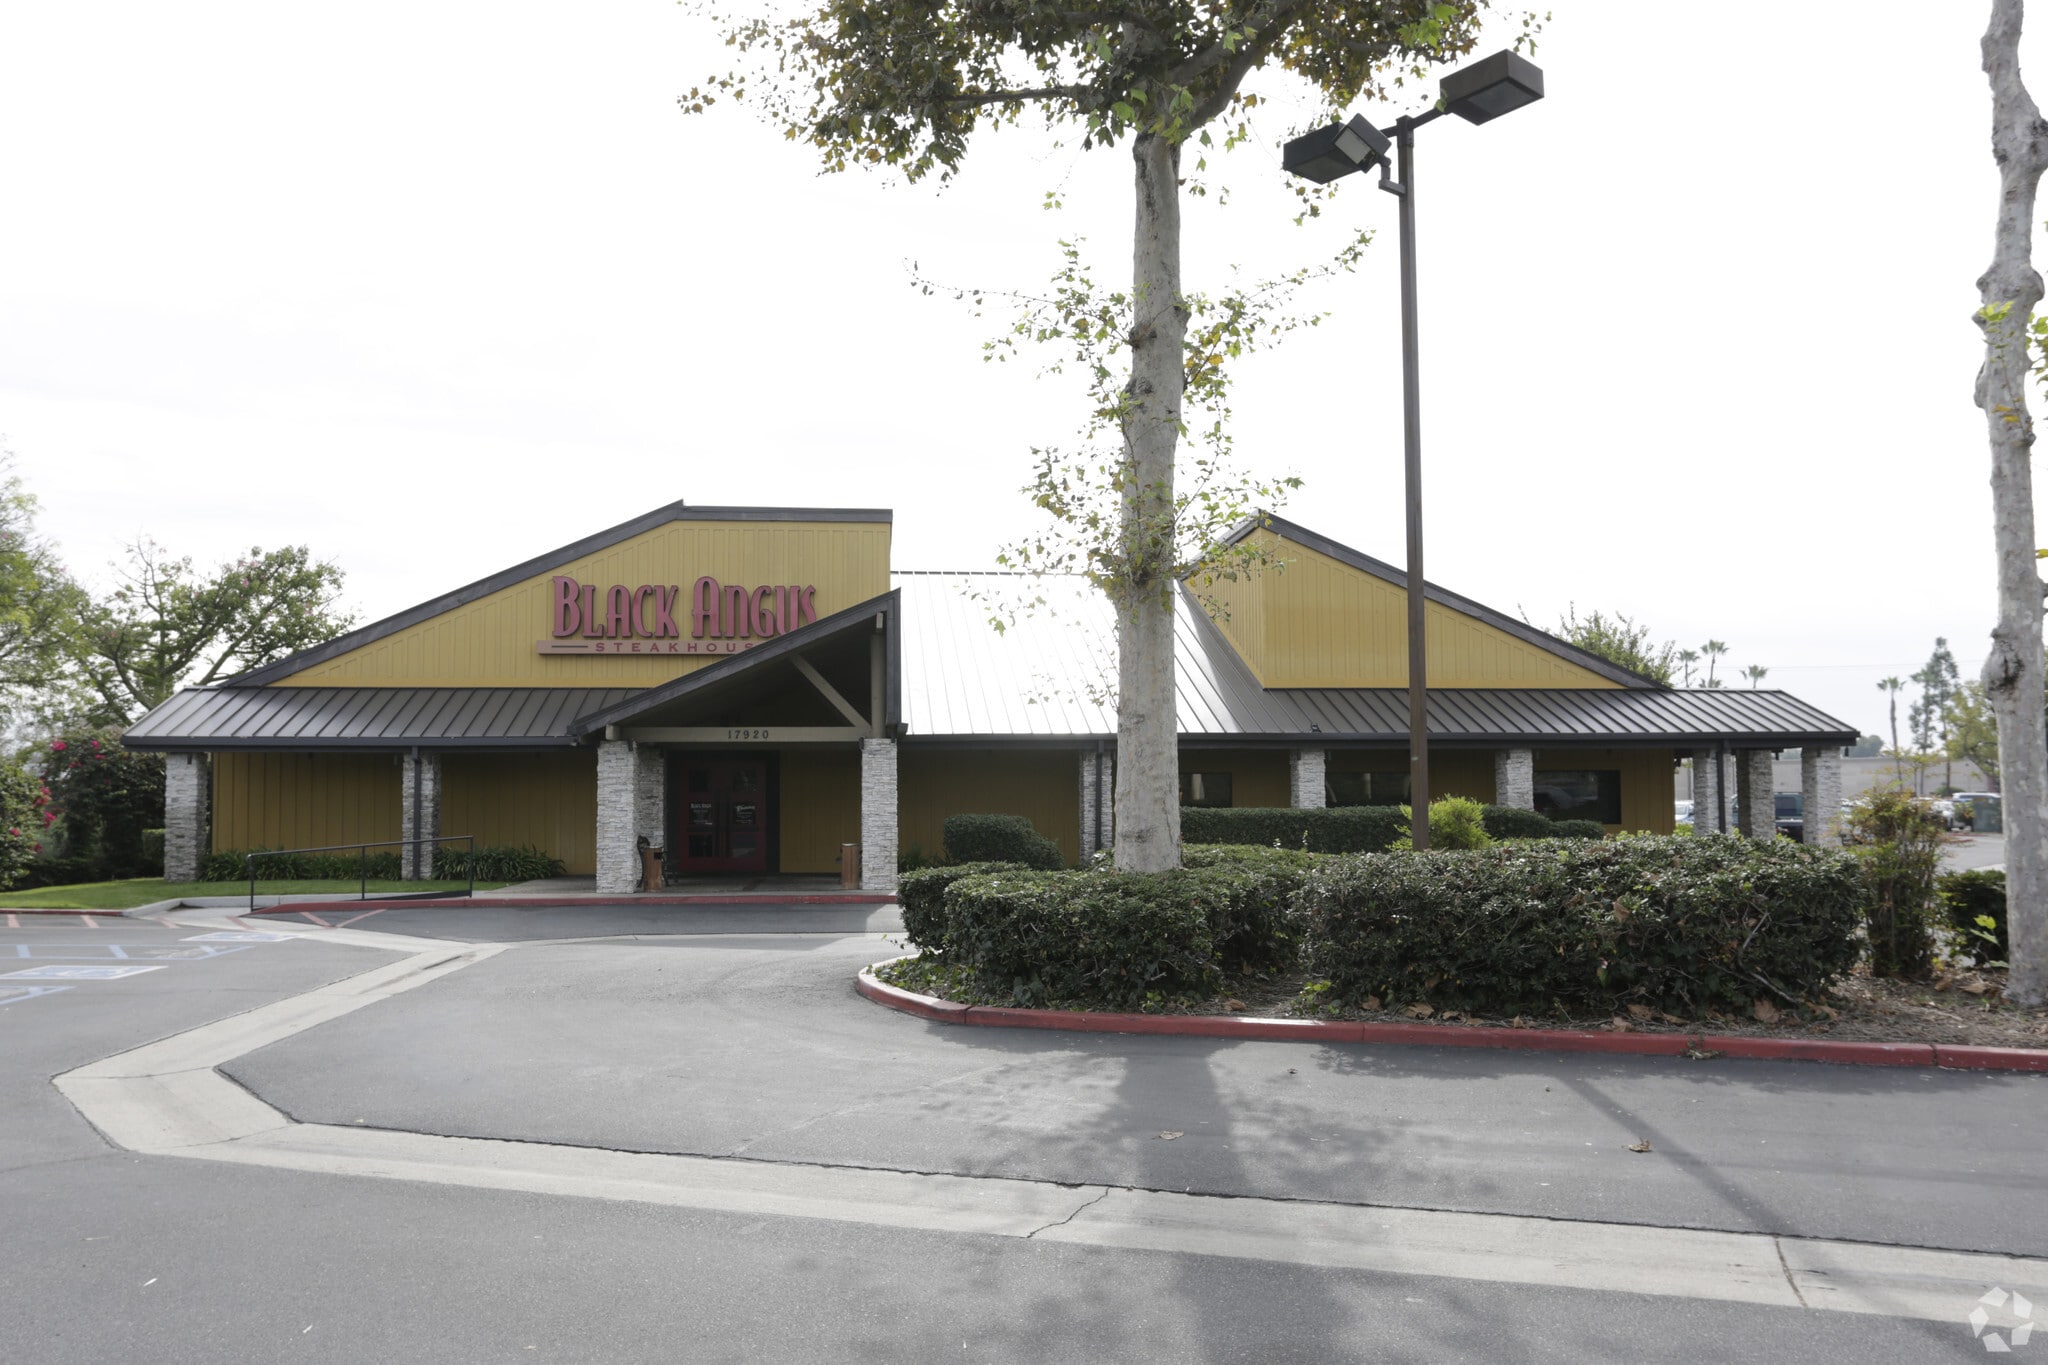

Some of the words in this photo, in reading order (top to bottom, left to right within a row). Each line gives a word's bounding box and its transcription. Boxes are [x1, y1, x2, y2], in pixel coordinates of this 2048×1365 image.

[552, 576, 679, 638] BLACK
[691, 576, 817, 638] ANGUS
[728, 730, 769, 740] 17920
